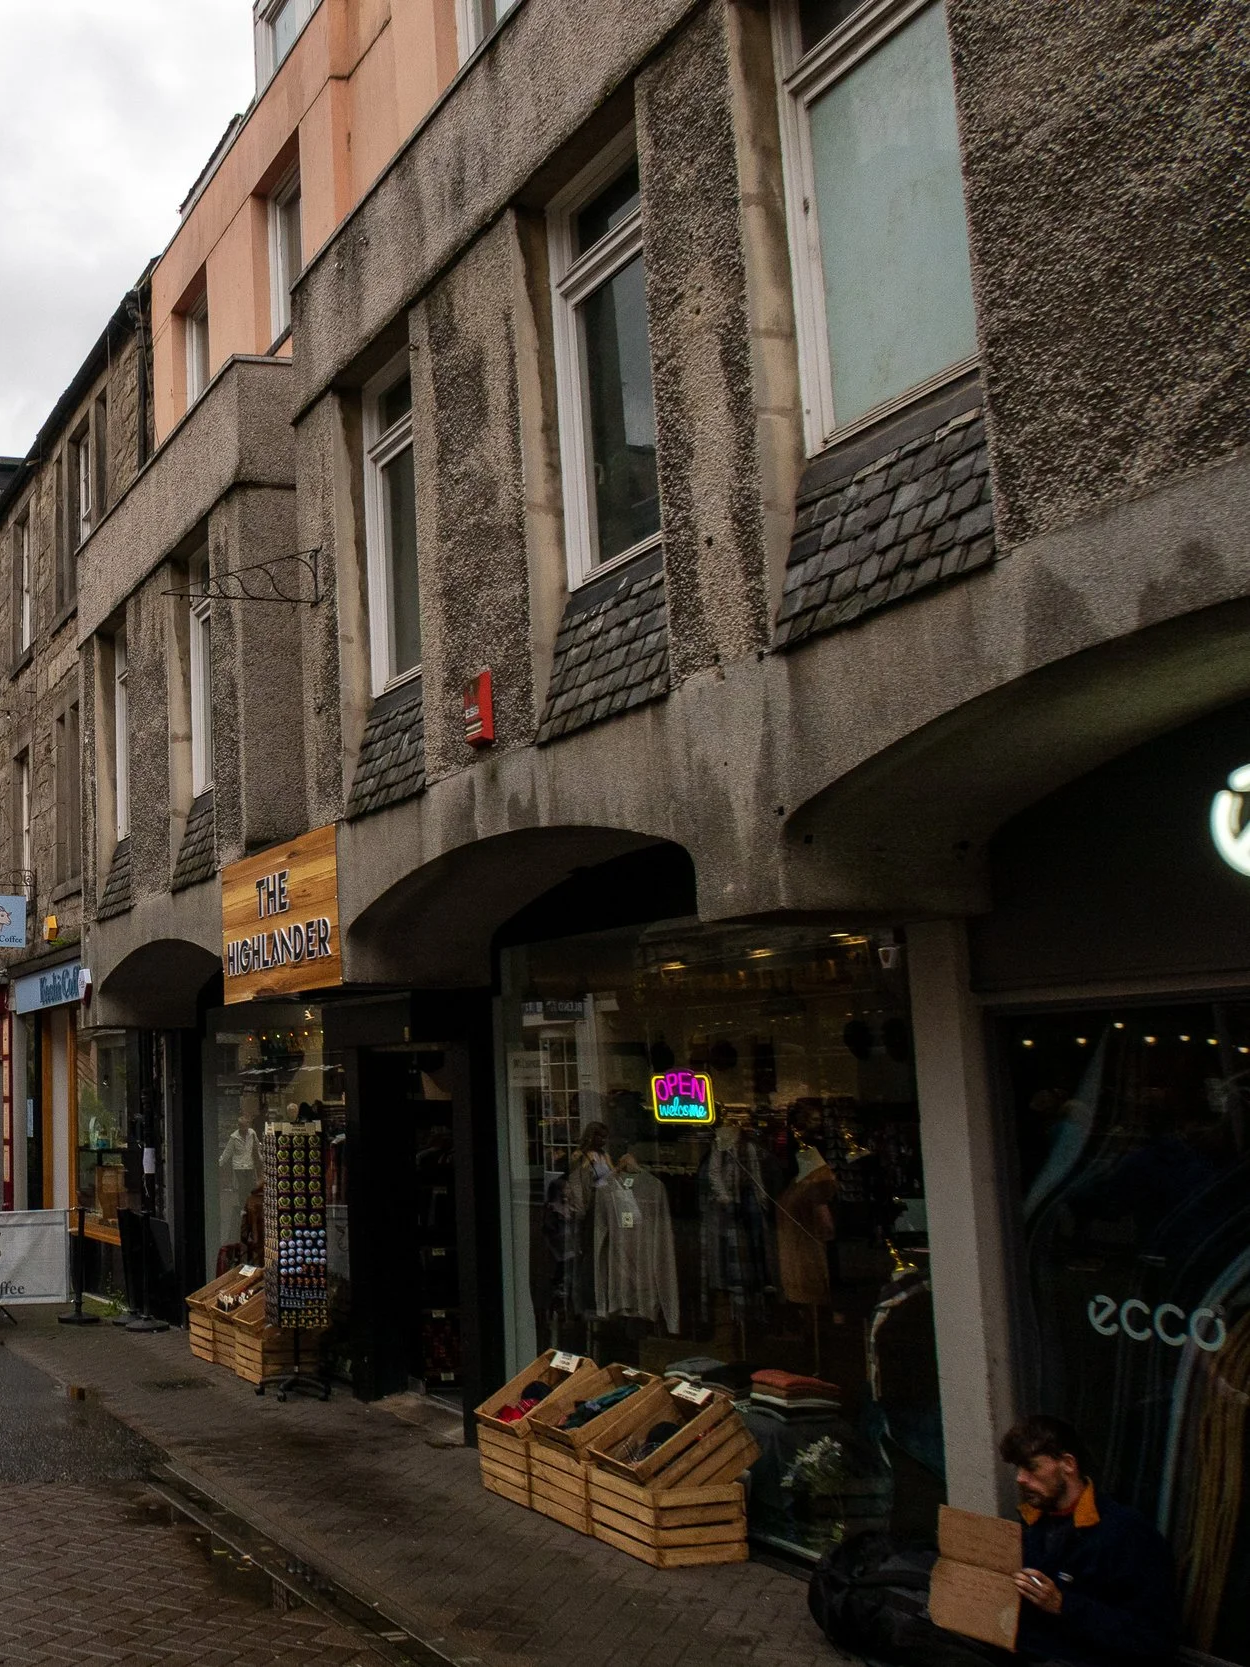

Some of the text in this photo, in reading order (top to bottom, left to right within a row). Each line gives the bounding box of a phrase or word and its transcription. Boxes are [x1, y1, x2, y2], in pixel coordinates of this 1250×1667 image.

[256, 869, 289, 918] THE
[0, 935, 23, 943] Coffee
[227, 917, 331, 977] HIGHLANDER
[39, 972, 62, 1005] Kechi
[656, 1072, 706, 1103] OPEN
[1088, 1294, 1227, 1352] ecco
